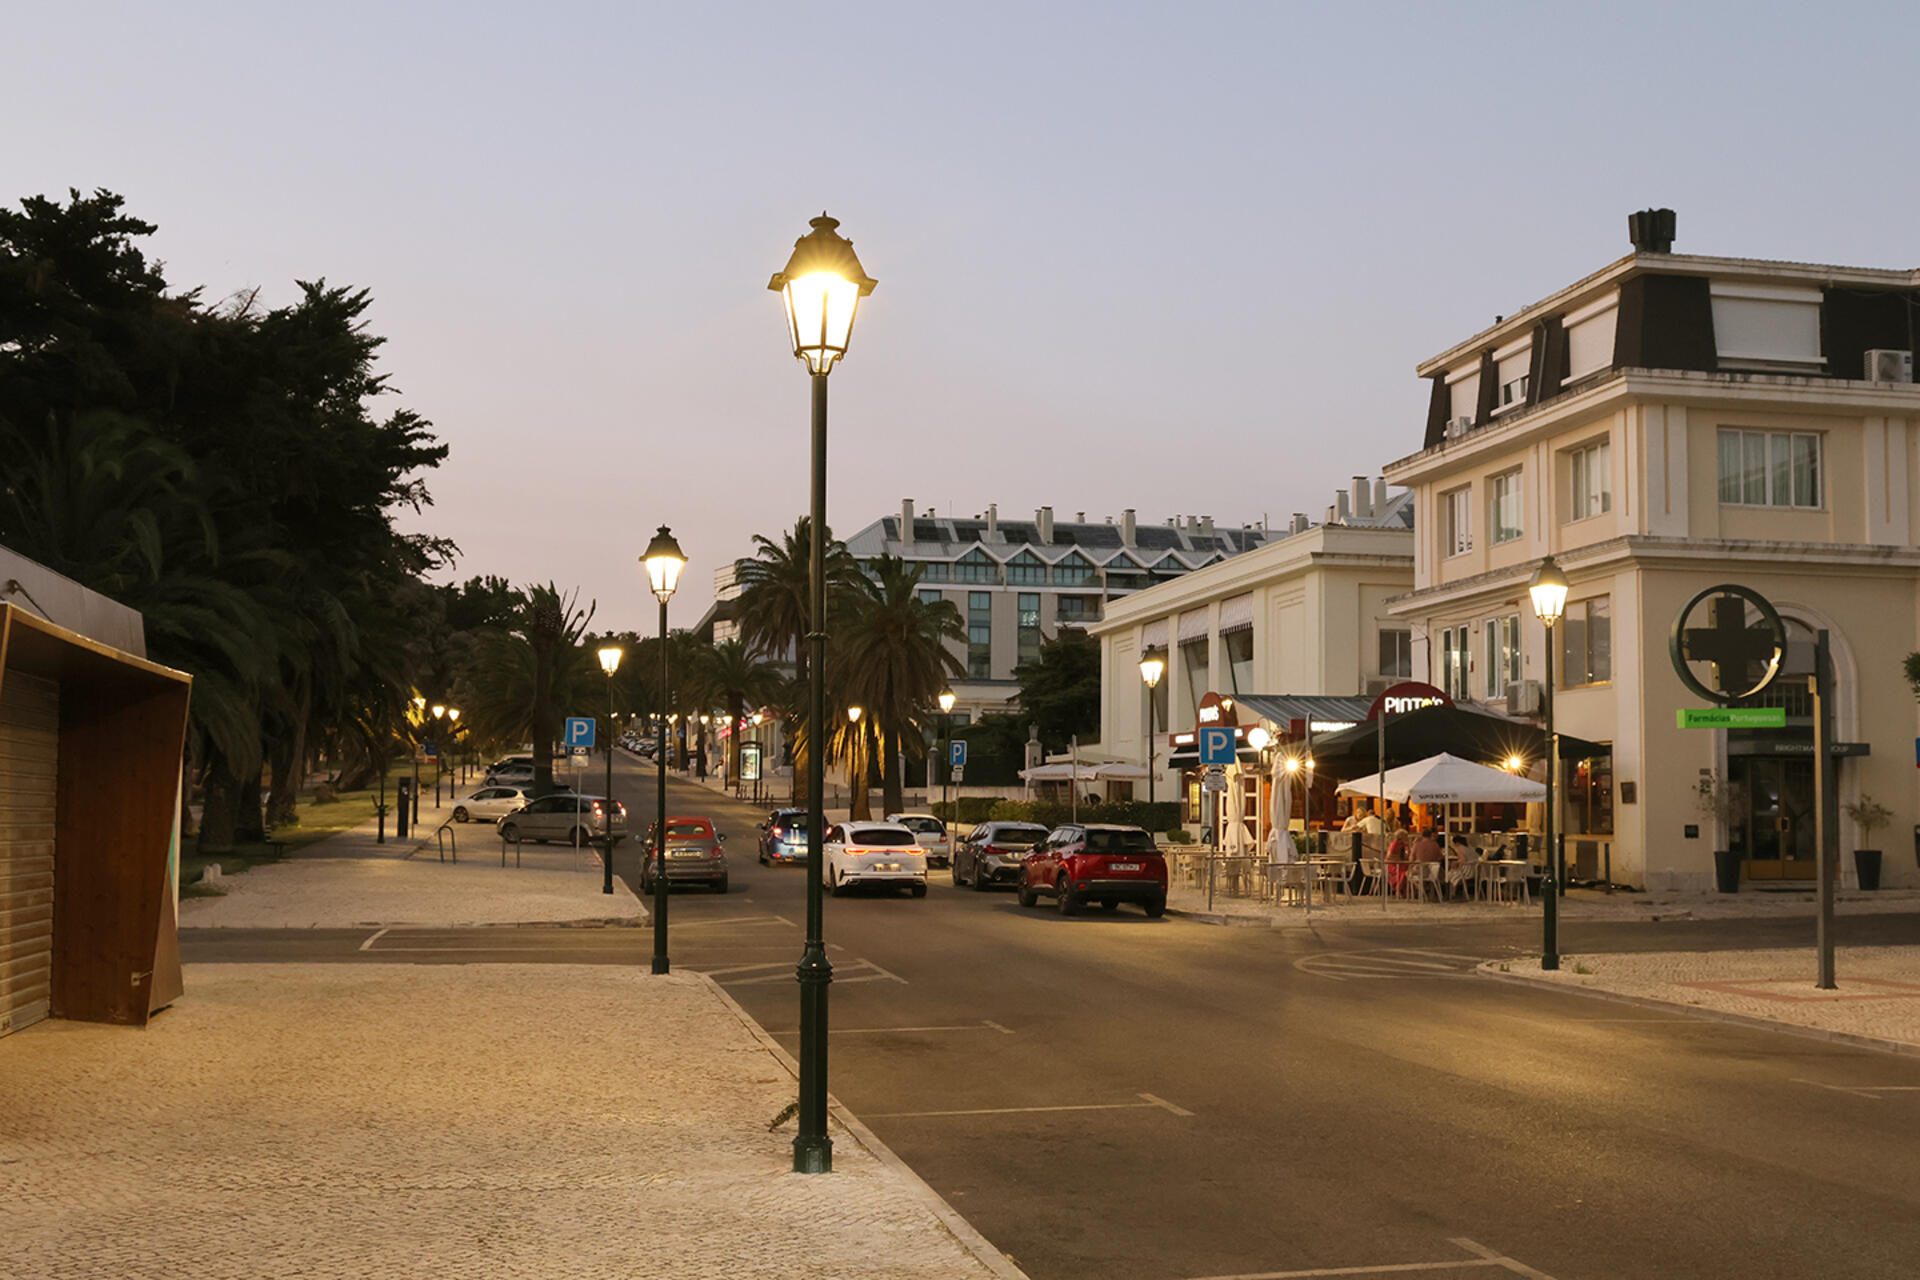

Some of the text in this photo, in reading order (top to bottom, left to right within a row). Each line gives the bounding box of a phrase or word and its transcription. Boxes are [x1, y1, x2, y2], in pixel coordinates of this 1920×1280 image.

[572, 721, 588, 743] P
[953, 744, 962, 762] P
[1208, 732, 1227, 760] P
